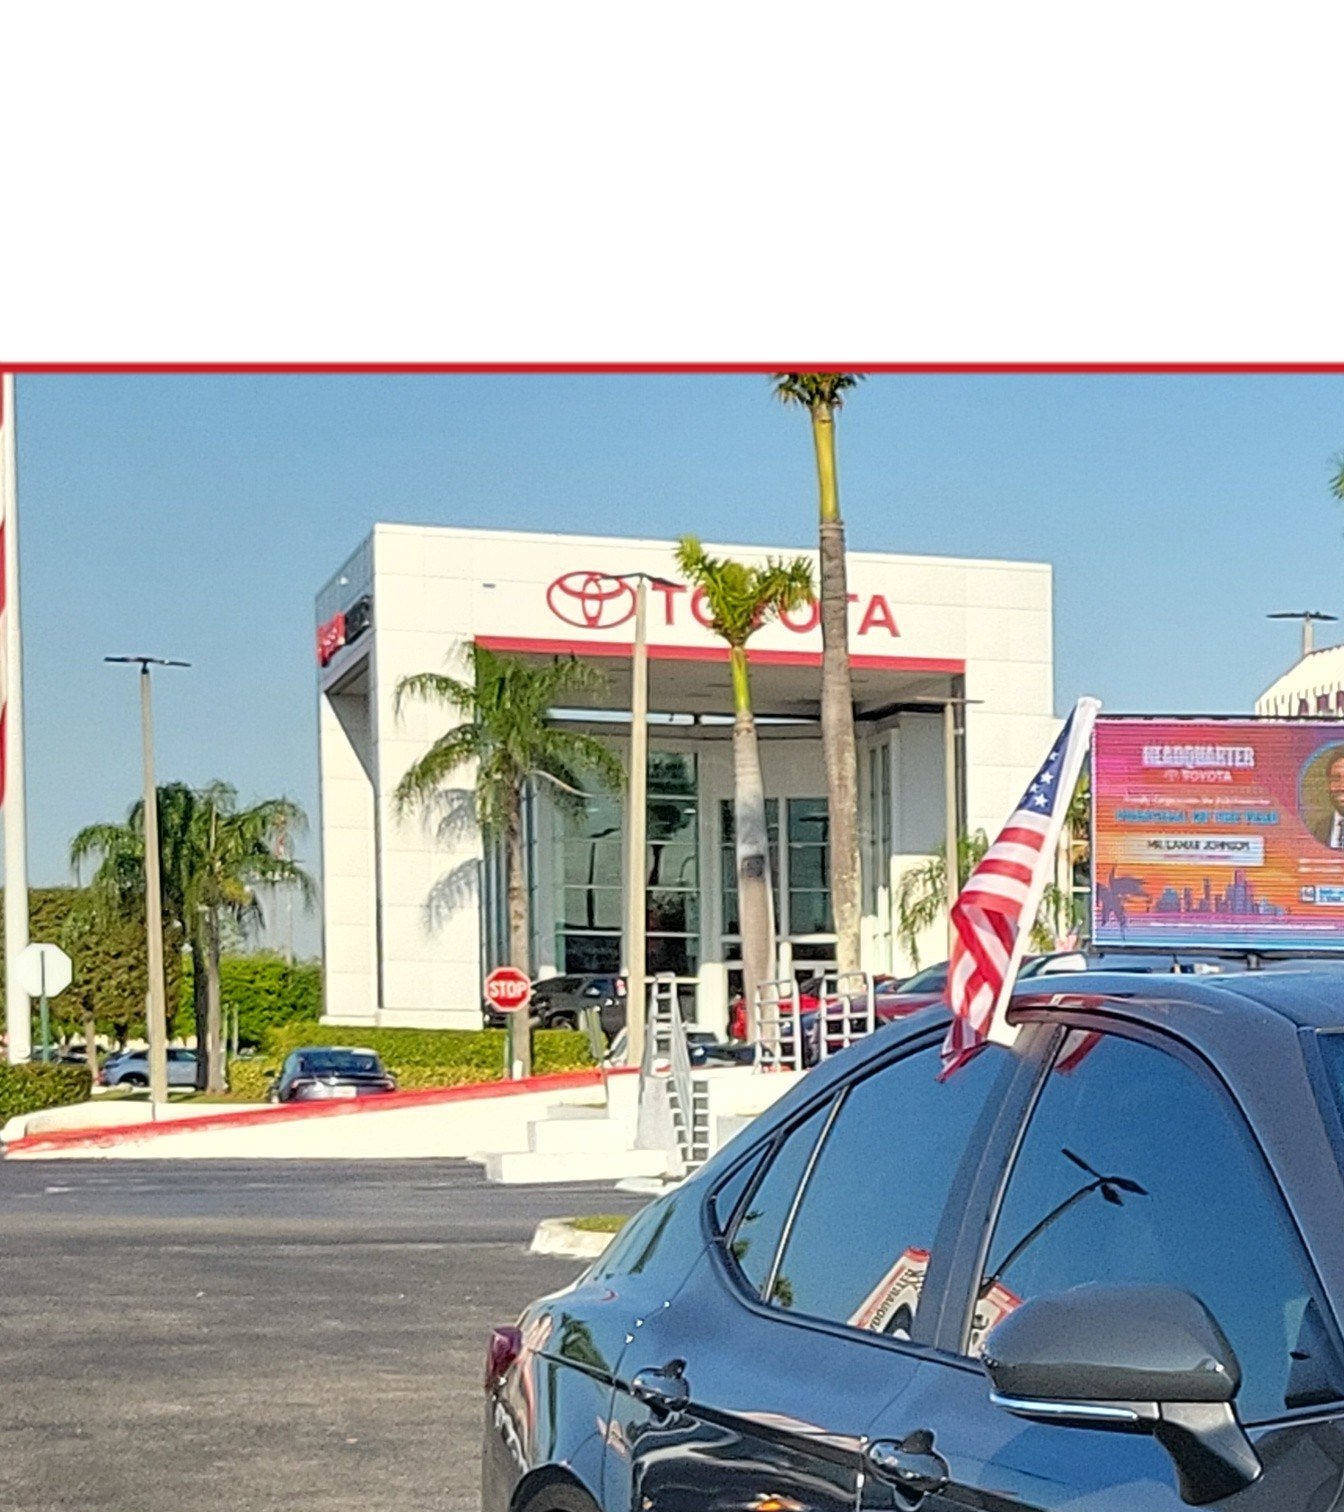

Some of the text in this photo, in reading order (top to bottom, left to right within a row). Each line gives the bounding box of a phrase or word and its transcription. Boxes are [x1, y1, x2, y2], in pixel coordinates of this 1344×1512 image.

[652, 582, 901, 637] TOOA
[1142, 745, 1255, 769] HEADQUARTER
[1181, 769, 1233, 782] TOYOTA
[489, 980, 527, 998] STOP
